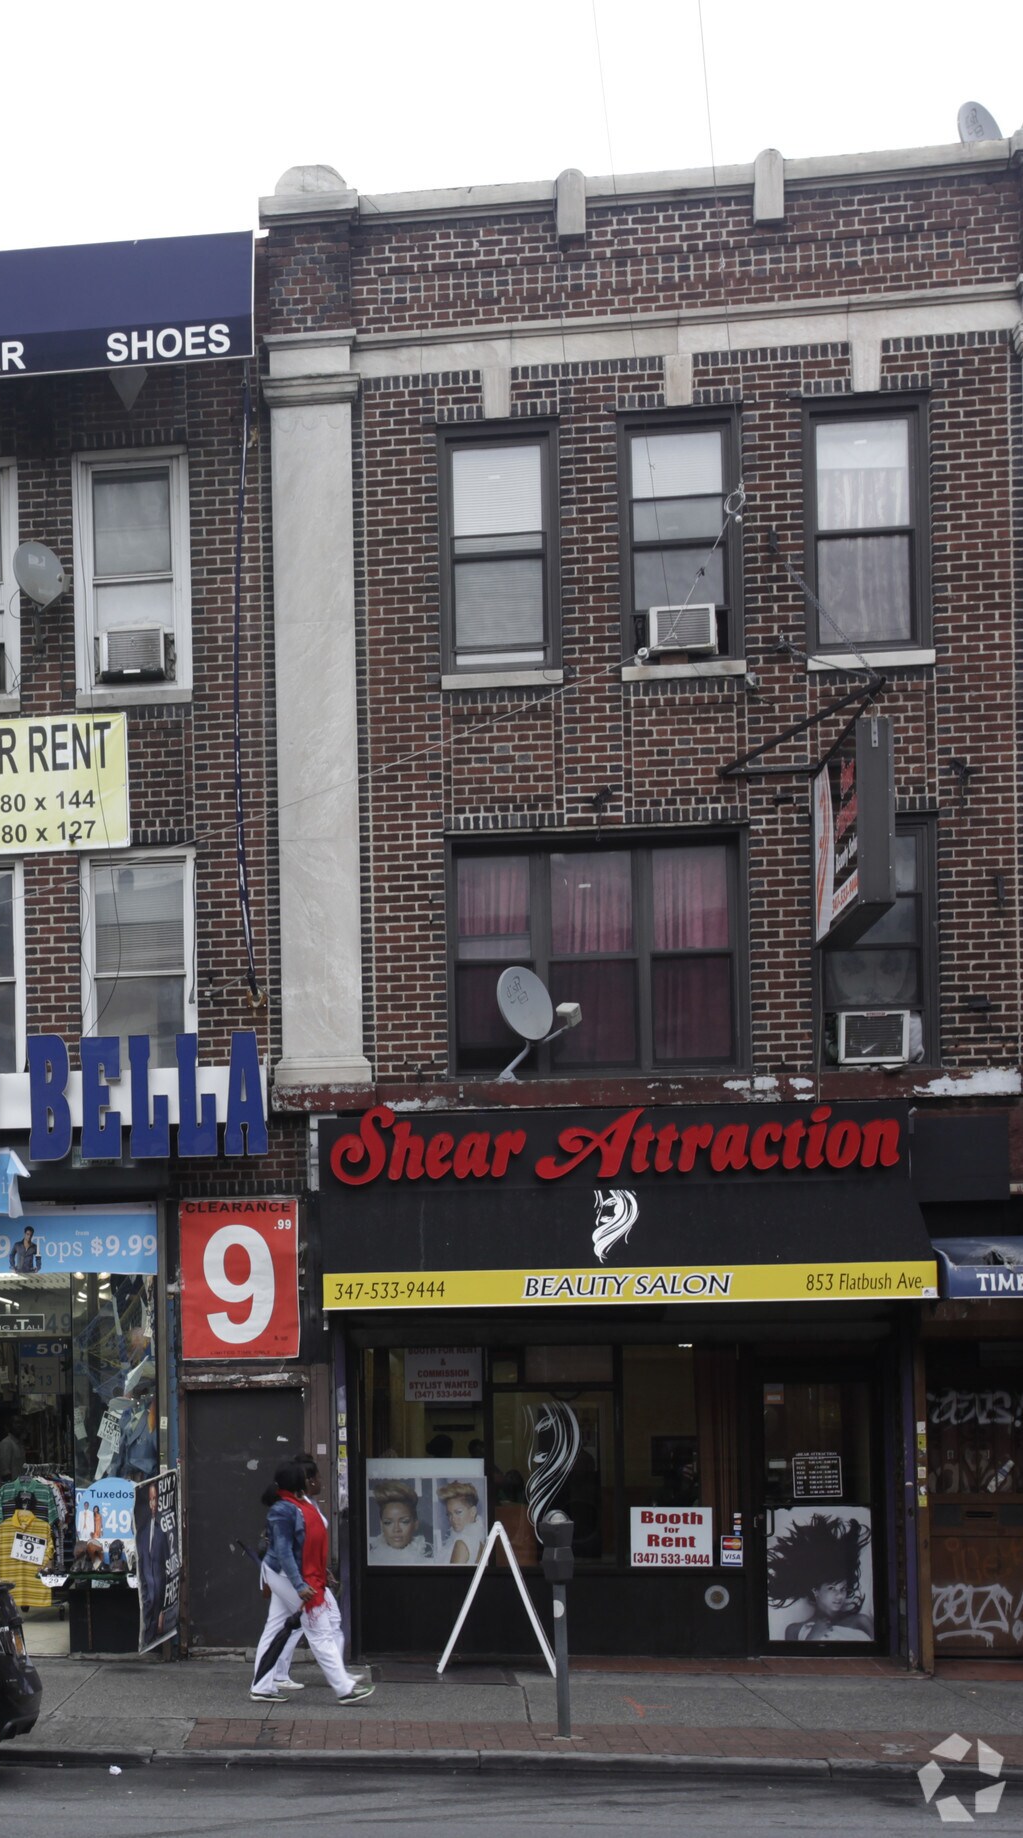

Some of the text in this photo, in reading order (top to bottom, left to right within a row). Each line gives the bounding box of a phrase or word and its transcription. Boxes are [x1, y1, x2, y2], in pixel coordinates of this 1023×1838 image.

[107, 323, 231, 362] SHOES
[29, 722, 112, 773] RENT
[34, 796, 47, 811] x
[56, 789, 96, 810] 144
[36, 827, 48, 841] x
[57, 820, 97, 841] 127
[26, 1030, 269, 1162] BELLA
[329, 1105, 901, 1186] Shear Attraction
[185, 1202, 291, 1214] CLEARANCE
[31, 1235, 83, 1263] Tops
[90, 1234, 157, 1258] $9.99
[203, 1224, 275, 1344] 9
[334, 1271, 925, 1300] 347-533-9444 BEAUTY SALON 853 Flatbush Ave.
[417, 1369, 470, 1378] COMMISSION
[409, 1380, 478, 1390] STYLIST WANTED
[90, 1489, 134, 1499] Tuxedos
[158, 1491, 174, 1512] SUIT
[160, 1512, 175, 1532] GET
[640, 1511, 703, 1526] Booth
[22, 1535, 40, 1543] SALE
[664, 1526, 680, 1534] for
[647, 1534, 696, 1548] Rent
[633, 1552, 710, 1565] (347) 533-9444
